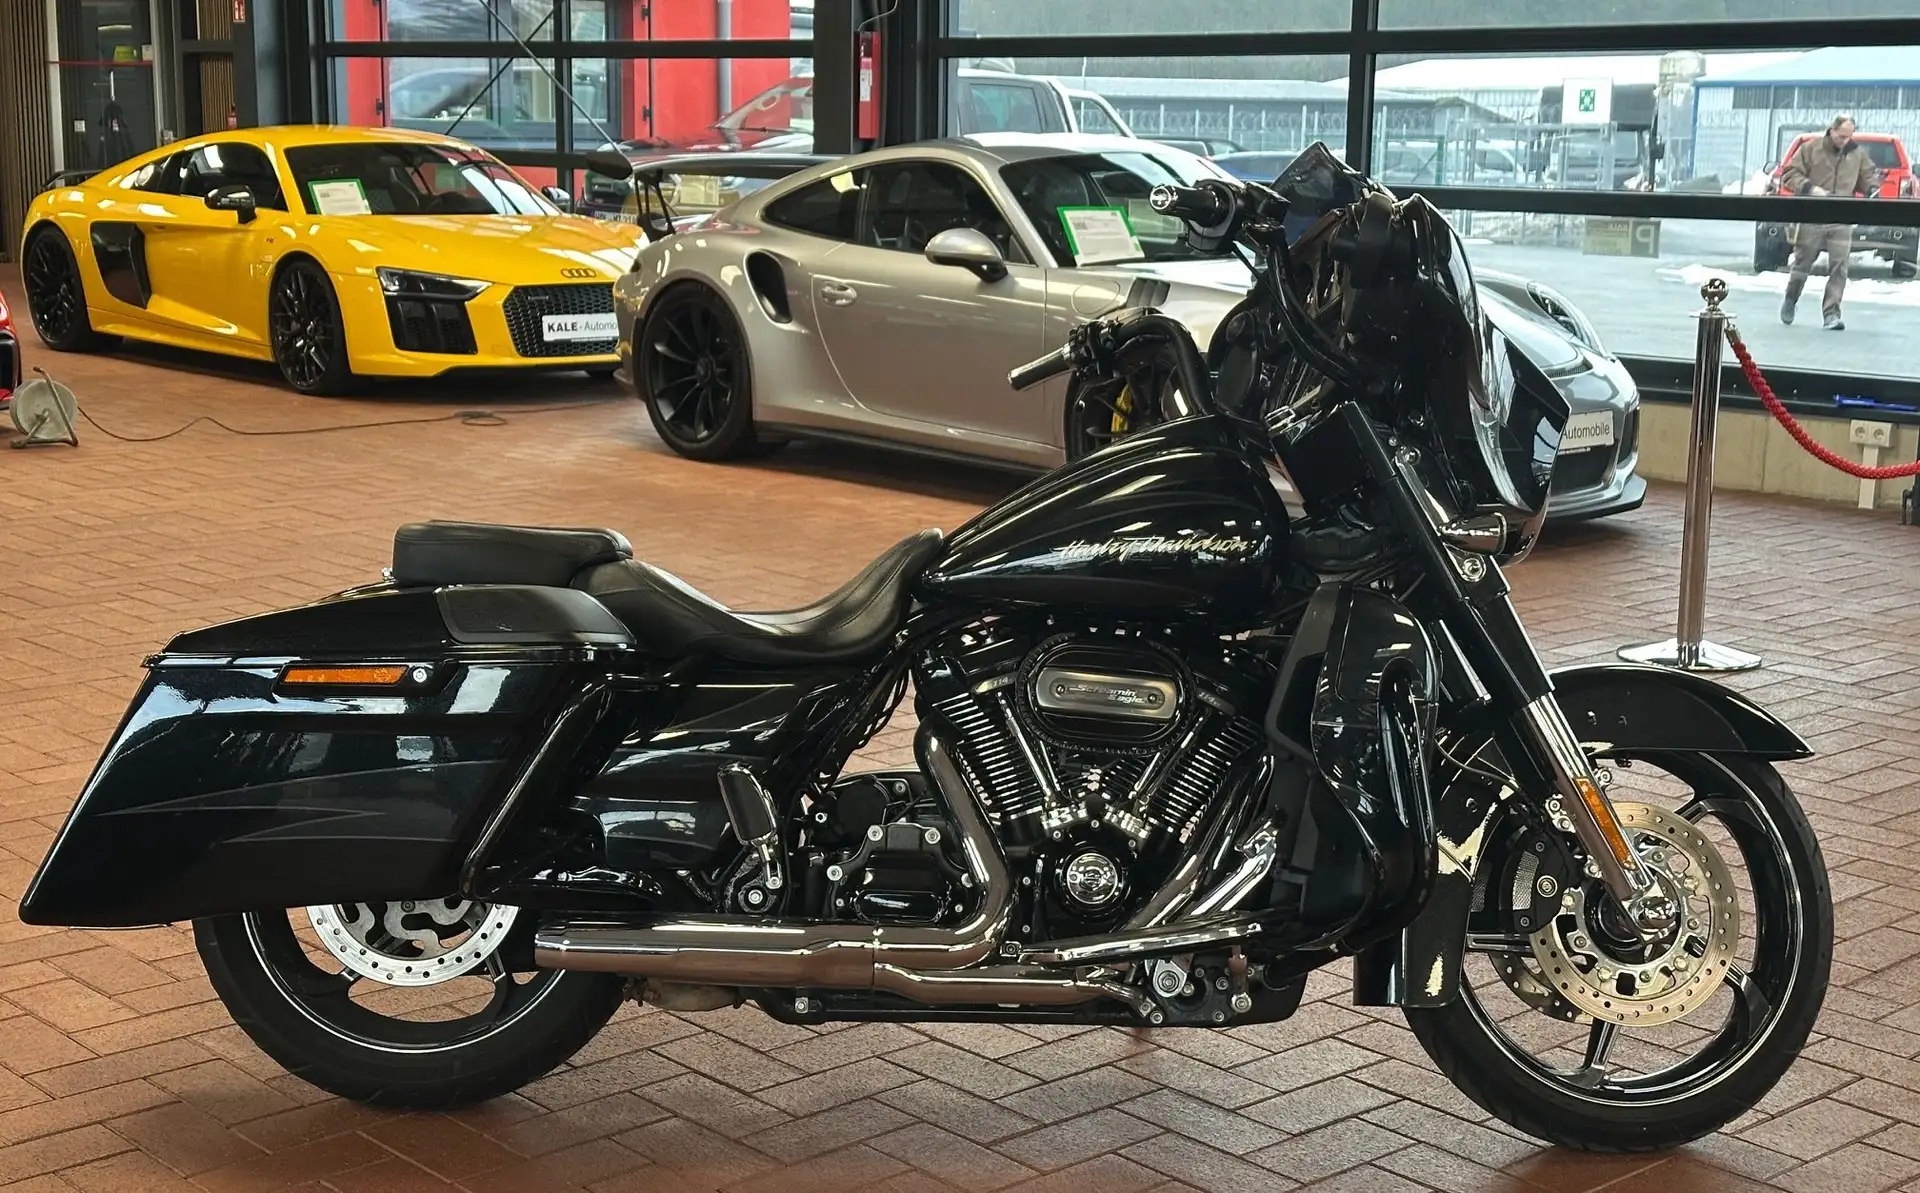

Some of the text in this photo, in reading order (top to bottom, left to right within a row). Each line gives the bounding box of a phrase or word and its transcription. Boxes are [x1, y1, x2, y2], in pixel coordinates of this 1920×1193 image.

[547, 321, 578, 333] KALE
[1562, 422, 1610, 440] Automobile
[1052, 533, 1250, 563] Harley-Davidson
